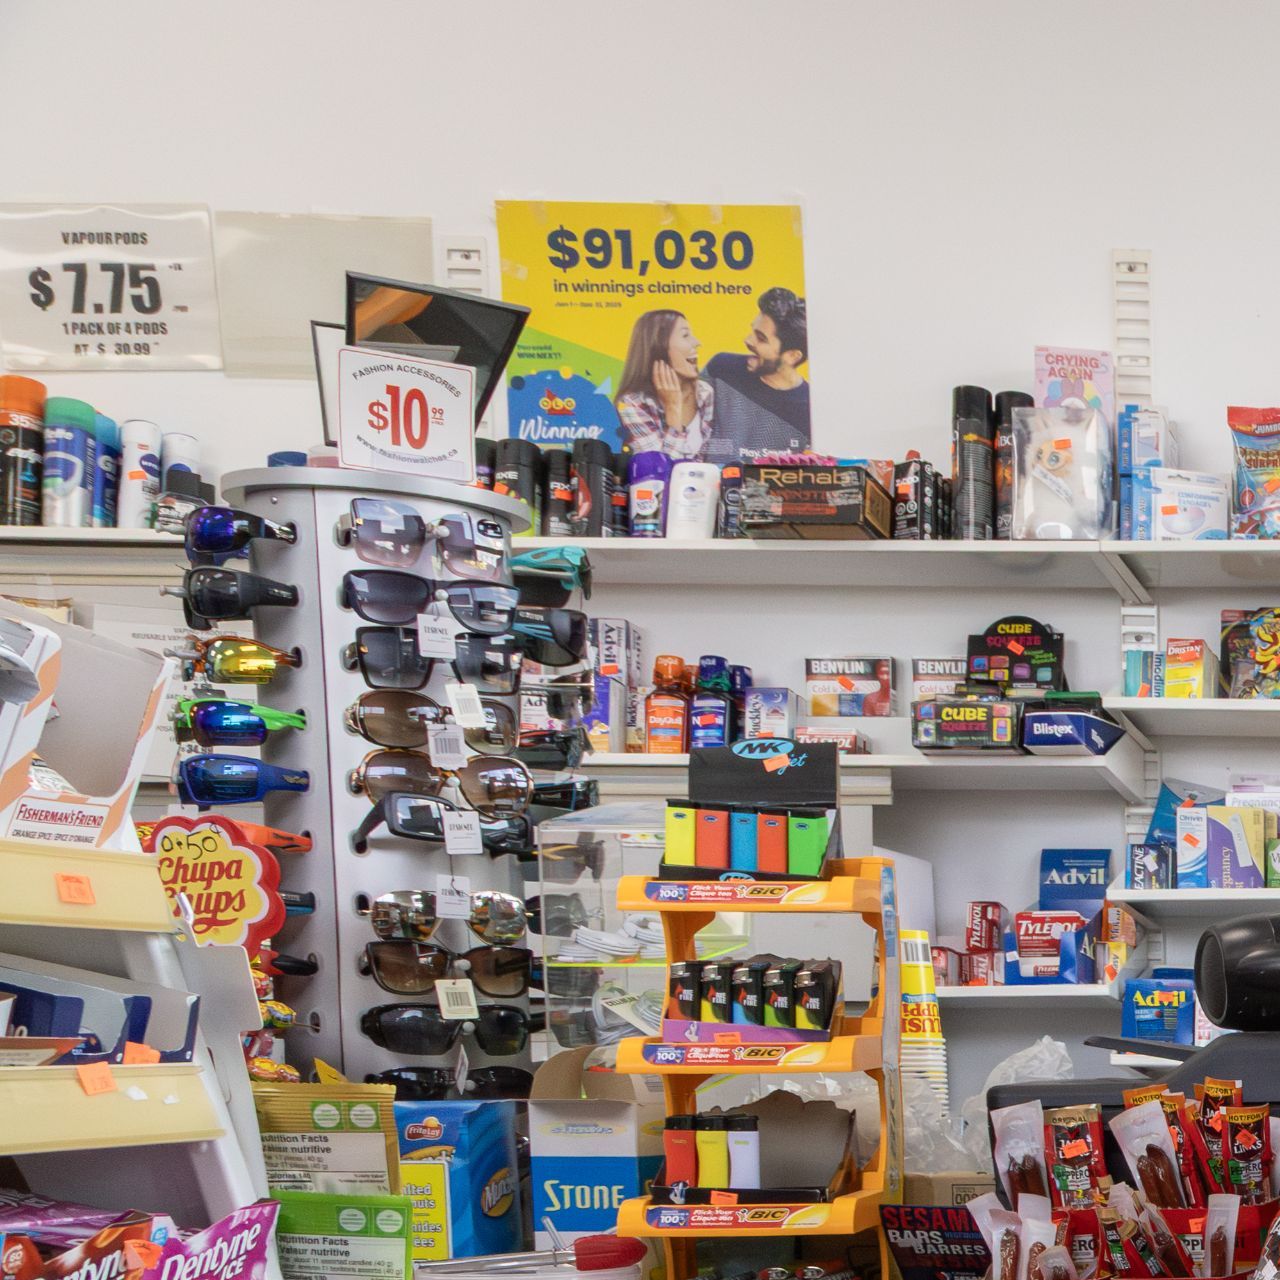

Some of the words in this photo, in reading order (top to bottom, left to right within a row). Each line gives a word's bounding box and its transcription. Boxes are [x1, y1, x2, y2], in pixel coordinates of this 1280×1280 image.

[115, 232, 148, 245] PODS
[547, 224, 754, 277] $91,030
[62, 263, 162, 315] 7.75
[553, 279, 568, 293] in
[571, 279, 644, 297] winnings
[648, 280, 713, 295] claimed
[716, 281, 752, 295] here
[72, 322, 104, 335] PACK
[108, 322, 123, 335] OF
[135, 322, 168, 335] PODS
[1045, 353, 1100, 369] CRYING
[352, 364, 393, 380] FASHION
[396, 364, 462, 398] ACCESSORIES
[1047, 366, 1094, 381] AGAIN
[519, 416, 603, 440] Winning
[759, 467, 851, 486] Rehab
[997, 623, 1032, 634] CUBE
[604, 624, 617, 664] Advil
[811, 660, 865, 674] BENYLIN
[649, 716, 682, 726] DayQuil
[941, 707, 988, 721] CUBE
[1033, 722, 1073, 737] Blistex
[159, 856, 242, 890] Chupa
[1044, 868, 1105, 886] Advil
[543, 1180, 624, 1212] STONE
[323, 1237, 349, 1246] Facts
[887, 1230, 945, 1244] BARS
[311, 1248, 350, 1257] nutritive
[915, 1244, 986, 1255] BARRES
